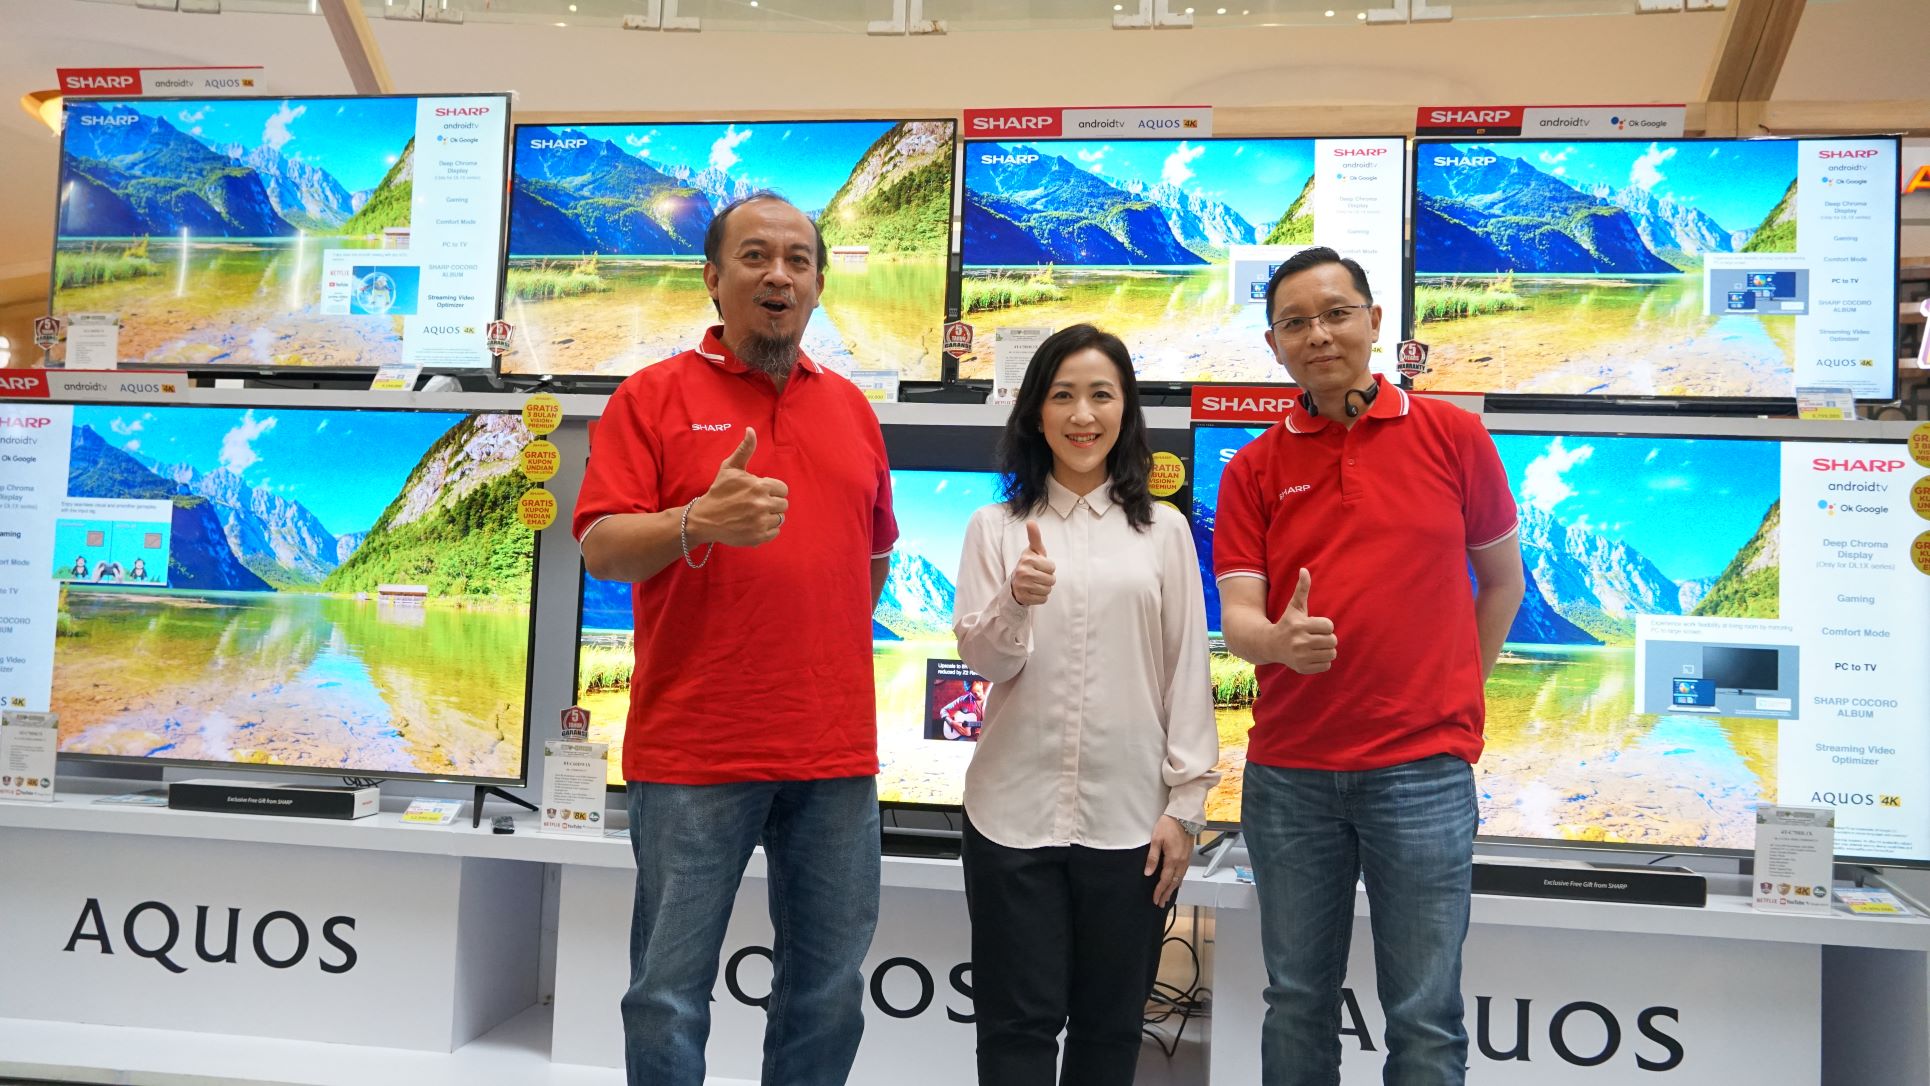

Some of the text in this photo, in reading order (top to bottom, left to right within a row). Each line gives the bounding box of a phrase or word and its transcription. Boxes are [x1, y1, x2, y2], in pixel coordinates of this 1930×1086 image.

[66, 76, 134, 89] SHARP
[155, 79, 194, 88] androidtv
[205, 79, 240, 88] AQUOS
[435, 107, 490, 116] SHARP
[80, 115, 139, 126] SHARP
[1430, 110, 1511, 124] SHARP
[973, 116, 1053, 130] SHARP
[1078, 119, 1125, 128] androidtv
[1138, 119, 1197, 130] AQUOS 4K
[1539, 118, 1590, 127] androidtv
[1641, 120, 1667, 128] Google
[530, 139, 588, 149] SHARP
[1334, 148, 1387, 156] SHARP
[1818, 149, 1878, 159] SHARP
[981, 154, 1040, 164] SHARP
[1433, 156, 1497, 167] SHARP
[423, 326, 460, 335] AQUOS
[955, 325, 962, 334] 5
[1408, 344, 1416, 354] 5
[1816, 359, 1857, 368] AQUOS
[0, 376, 39, 390] ARP
[64, 382, 108, 392] androidtv
[120, 384, 160, 394] AQUOS
[1201, 397, 1294, 412] SHARP
[0, 417, 51, 428] HARP
[692, 423, 732, 431] SHARP
[0, 435, 38, 444] ndroidtv
[12, 455, 36, 464] Google
[1812, 458, 1906, 472] SHARP
[1828, 481, 1888, 492] androidtv
[1279, 484, 1311, 500] SHARP
[1841, 504, 1889, 515] Ok Google
[0, 531, 21, 539] aming
[1823, 539, 1888, 549] Deep Chroma
[1838, 551, 1874, 561] Display
[1837, 594, 1875, 605] Gaming
[1822, 627, 1890, 638] Comfort Mode
[1834, 662, 1849, 671] PC
[12, 698, 25, 706] 4K
[1814, 696, 1898, 708] SHARP COCORO
[572, 710, 578, 722] 5
[1837, 709, 1874, 719] ALBUM
[1816, 744, 1896, 755] Streaming Video
[1832, 755, 1879, 766] Optimizer
[1811, 792, 1900, 807] AQUOS 4K
[1796, 887, 1810, 896] 4K
[62, 898, 358, 974] AQUOS
[1339, 988, 1684, 1072] AUOS
